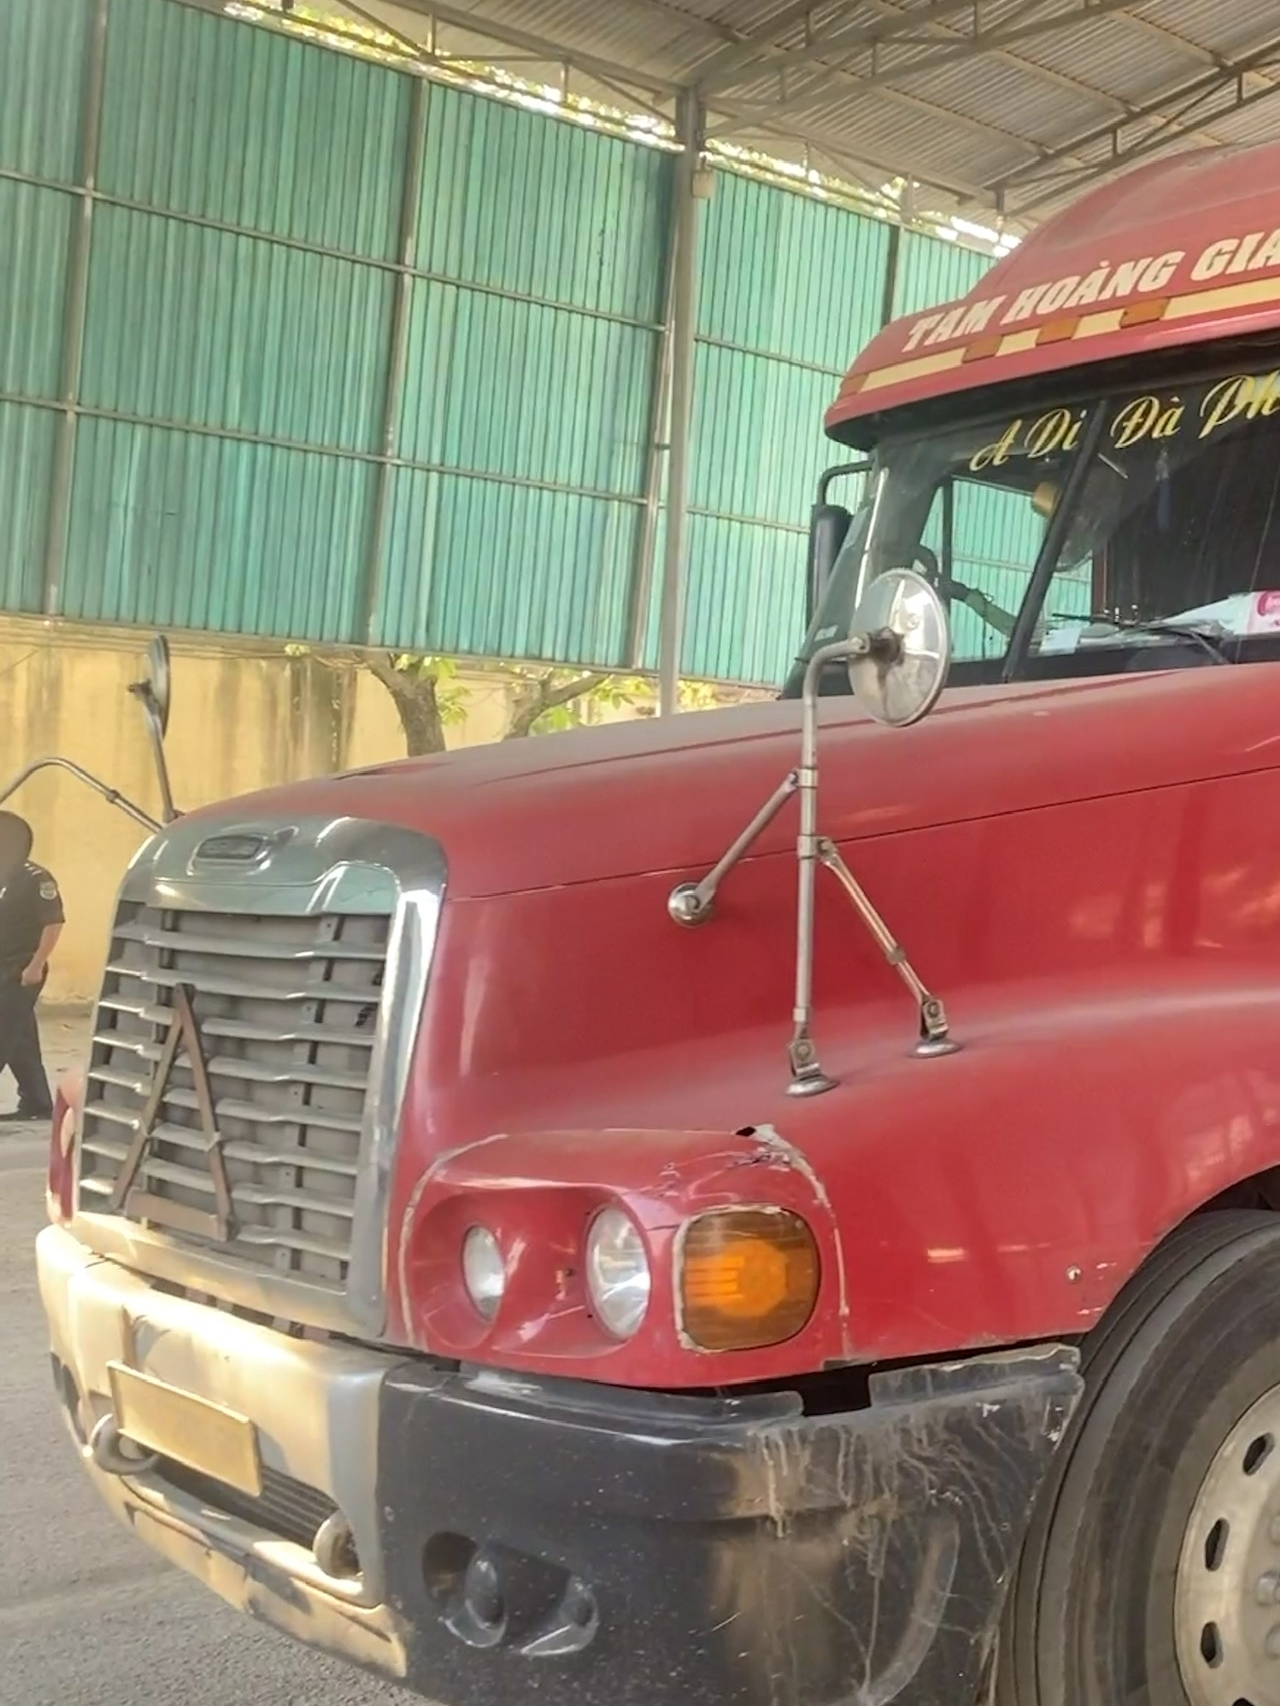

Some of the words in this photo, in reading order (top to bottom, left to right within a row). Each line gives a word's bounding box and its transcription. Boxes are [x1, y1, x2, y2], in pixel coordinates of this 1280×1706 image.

[1000, 251, 1186, 326] HOÀNG
[969, 418, 1022, 471] A
[1110, 396, 1185, 449] Đà
